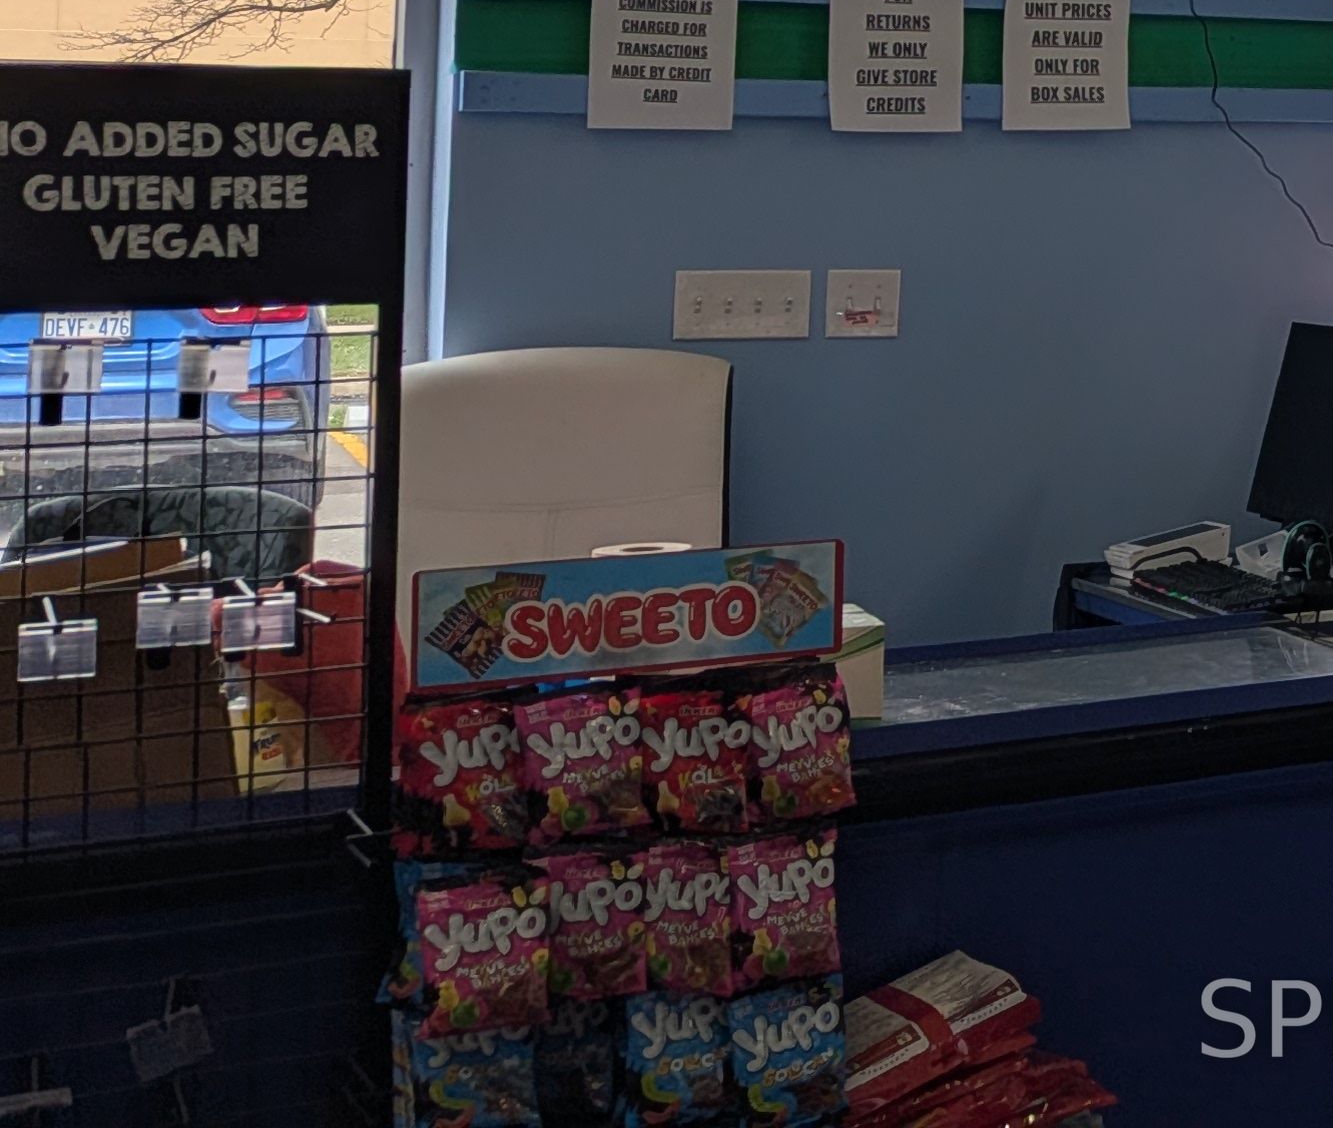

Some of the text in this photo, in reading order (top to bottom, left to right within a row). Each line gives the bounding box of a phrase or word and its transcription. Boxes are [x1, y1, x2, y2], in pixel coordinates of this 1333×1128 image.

[701, 0, 713, 15] IS
[1024, 2, 1112, 20] UNIT PRICES
[621, 19, 707, 37] CHARGED FOR
[866, 14, 931, 32] RETURNS
[1031, 31, 1103, 48] ARE VALID
[617, 42, 708, 59] TRANSACTIONS
[868, 42, 928, 59] WE ONLY
[611, 64, 712, 82] MADE BY CREDIT
[1034, 59, 1100, 75] ONLY FOR
[856, 69, 938, 86] GIVE STORE
[643, 88, 678, 103] CARD
[1031, 87, 1105, 103] BOX SALES
[866, 97, 926, 114] CREDITS
[63, 121, 224, 158] ADDED
[232, 122, 380, 158] SUGAR
[22, 174, 309, 212] GLUTEN FREE
[90, 223, 260, 260] VEGAN
[99, 318, 130, 336] 476
[507, 585, 757, 660] SWEETO
